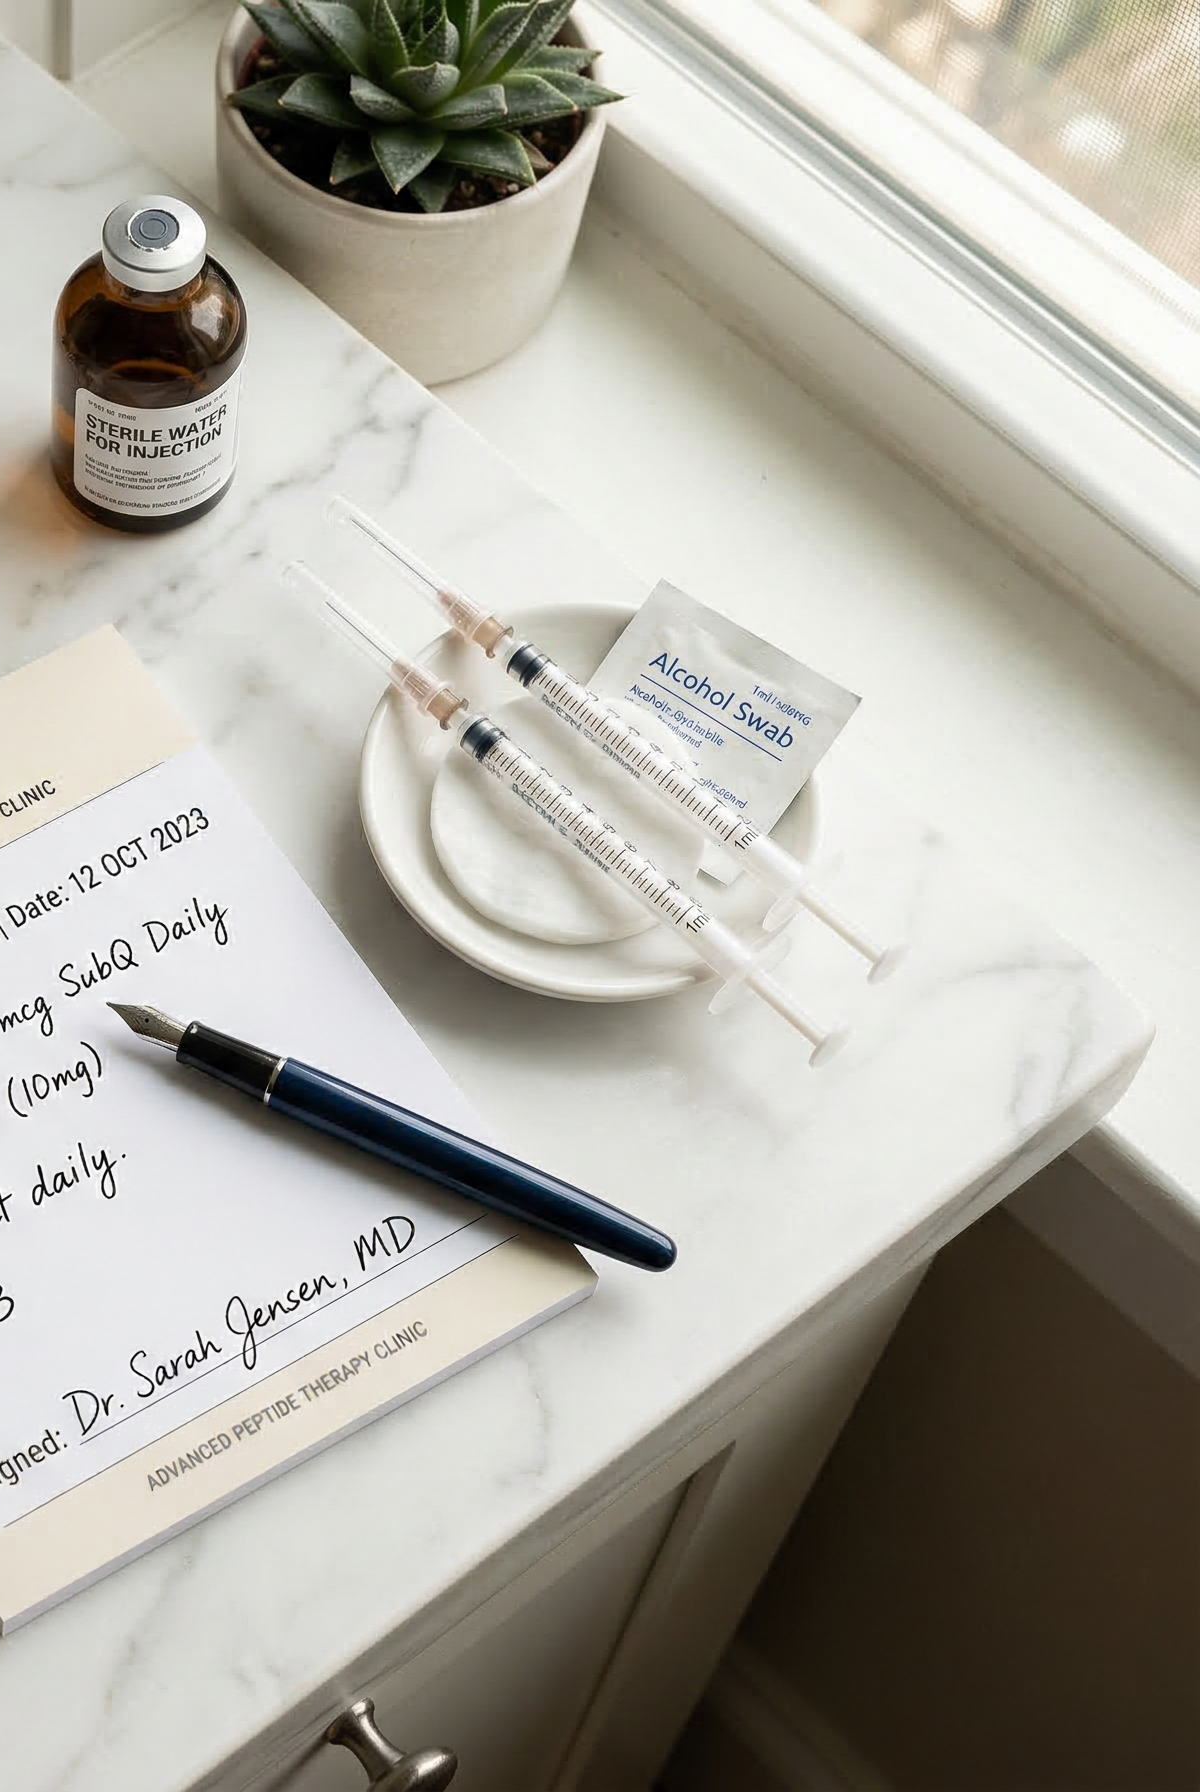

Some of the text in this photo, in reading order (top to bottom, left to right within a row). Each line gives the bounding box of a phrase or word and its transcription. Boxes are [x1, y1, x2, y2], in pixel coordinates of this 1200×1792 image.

[86, 413, 163, 442] STERILE
[169, 404, 227, 441] WATER
[86, 423, 222, 459] FOR INJECTION
[649, 652, 735, 711] Alcohol
[733, 702, 795, 750] Swab
[5, 885, 70, 928] Date:
[68, 865, 102, 893] 12
[101, 837, 148, 877] OCT
[150, 807, 209, 851] 2023
[58, 938, 139, 997] SubQ
[141, 897, 229, 953] Daily
[7, 1041, 103, 1117] (10mg)
[31, 1142, 127, 1206] daily.
[62, 1389, 125, 1436] Dr.
[130, 1331, 223, 1399] Sarah
[225, 1273, 348, 1371] Jensen,
[353, 1215, 416, 1272] MD
[146, 1320, 428, 1492] ADVANCED PEPTIDE THERAPY CLINIC
